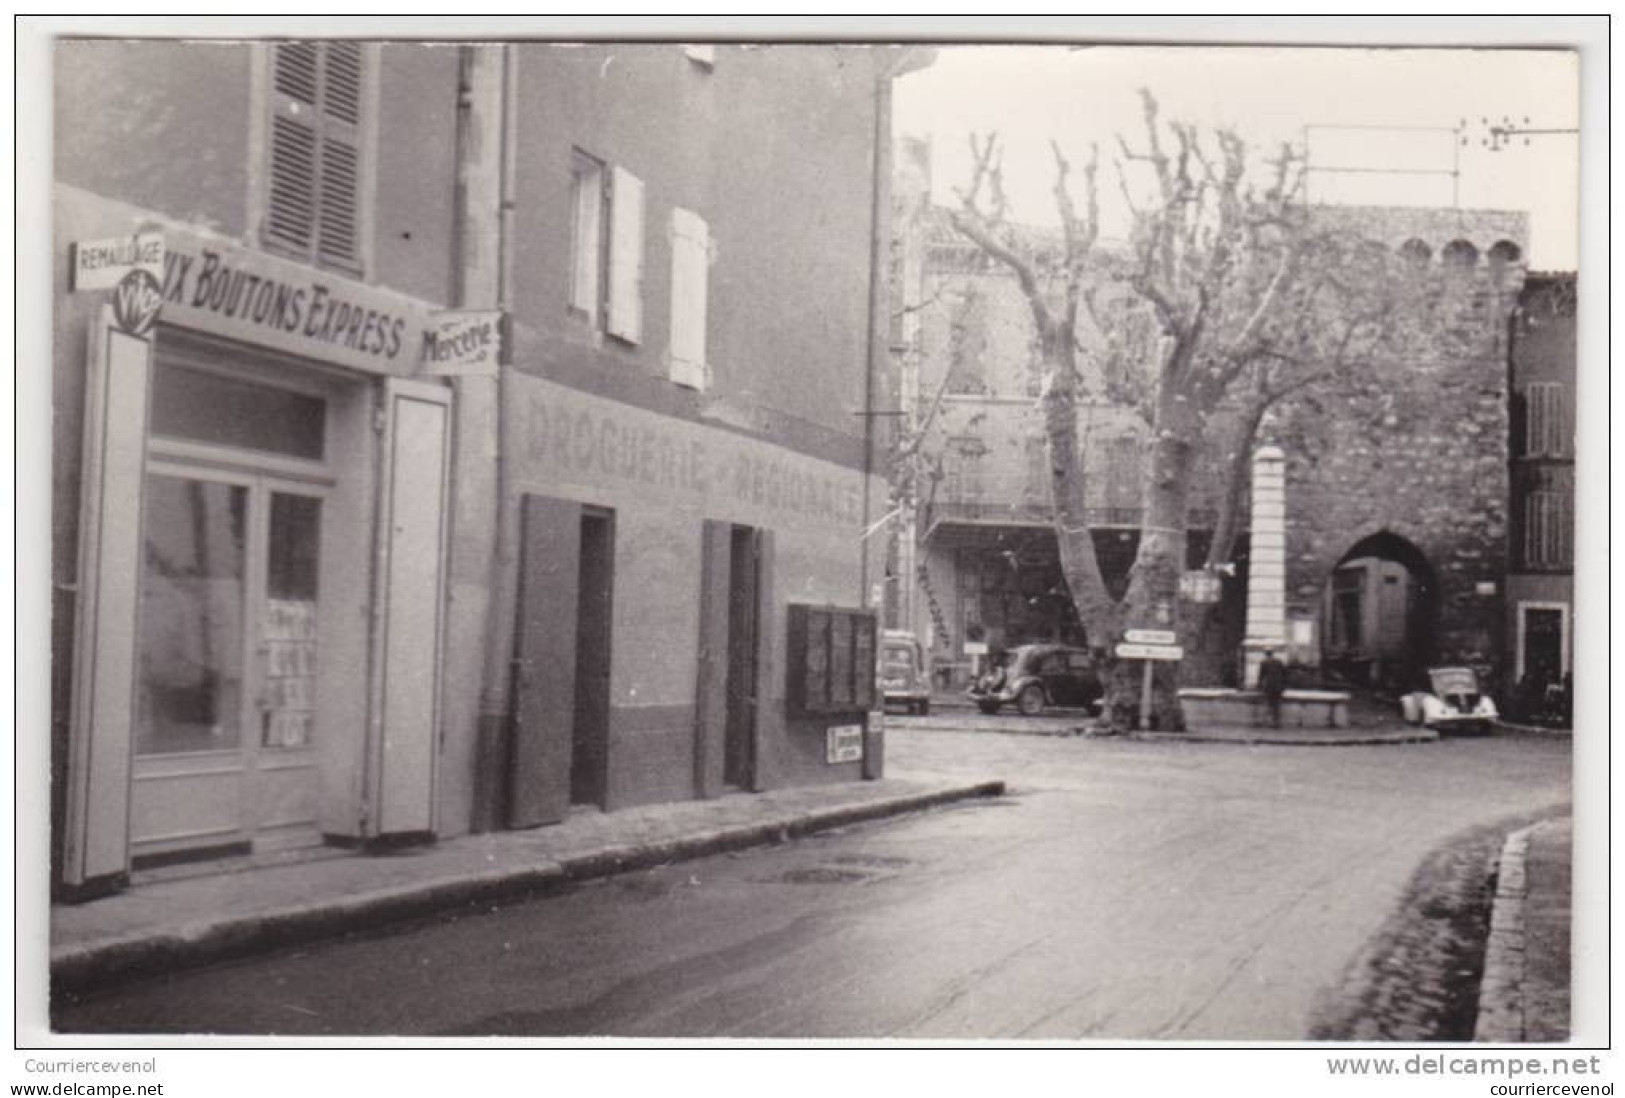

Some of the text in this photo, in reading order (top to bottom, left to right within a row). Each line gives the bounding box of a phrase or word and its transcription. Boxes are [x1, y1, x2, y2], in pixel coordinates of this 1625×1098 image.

[80, 241, 161, 269] REMAILLAGE
[421, 321, 491, 362] Mercerie
[526, 395, 709, 493] DROGUERIE
